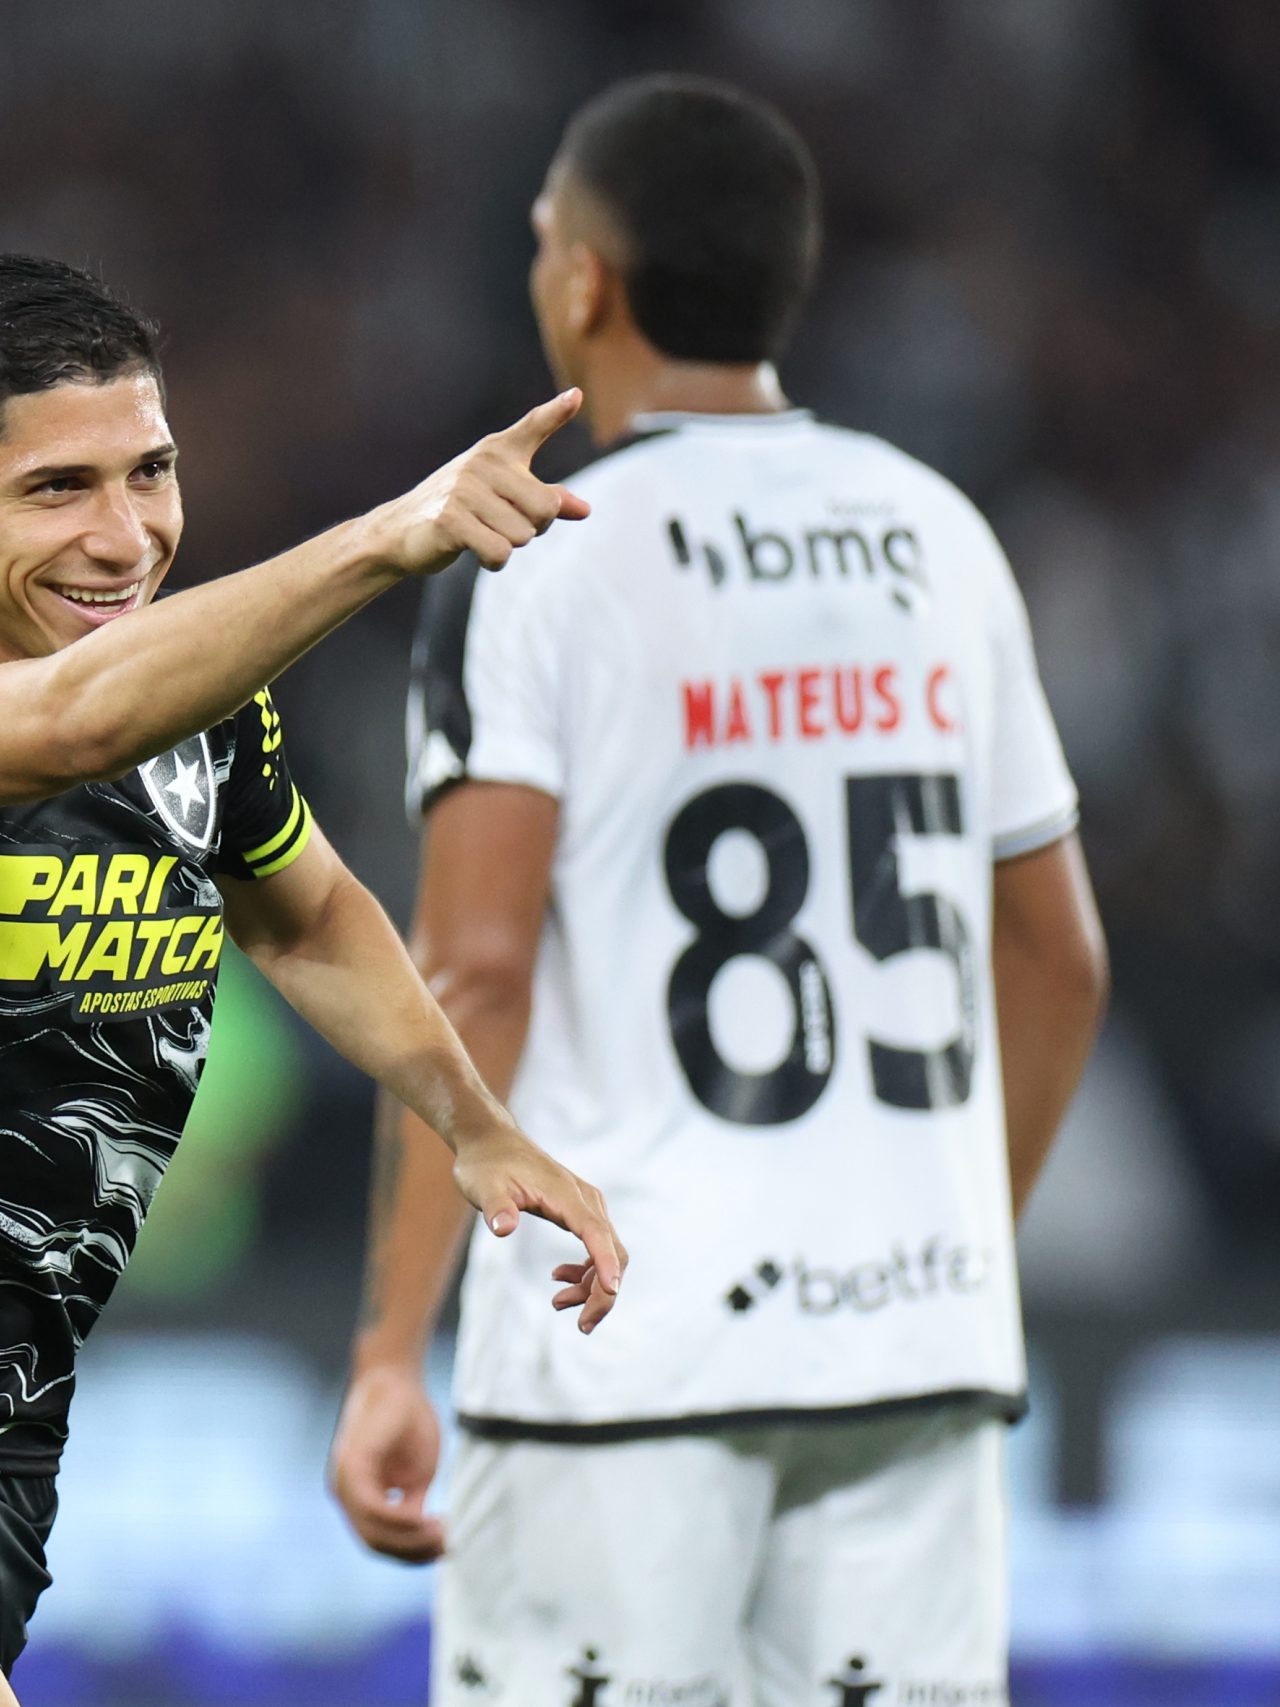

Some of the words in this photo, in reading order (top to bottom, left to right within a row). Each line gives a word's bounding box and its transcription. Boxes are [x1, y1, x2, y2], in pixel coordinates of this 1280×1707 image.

[732, 508, 928, 611] bmg
[681, 664, 900, 753] MATEUS
[78, 990, 144, 1014] APOSTAS
[140, 979, 209, 1009] ESPORTIVAS
[663, 772, 975, 1133] 85
